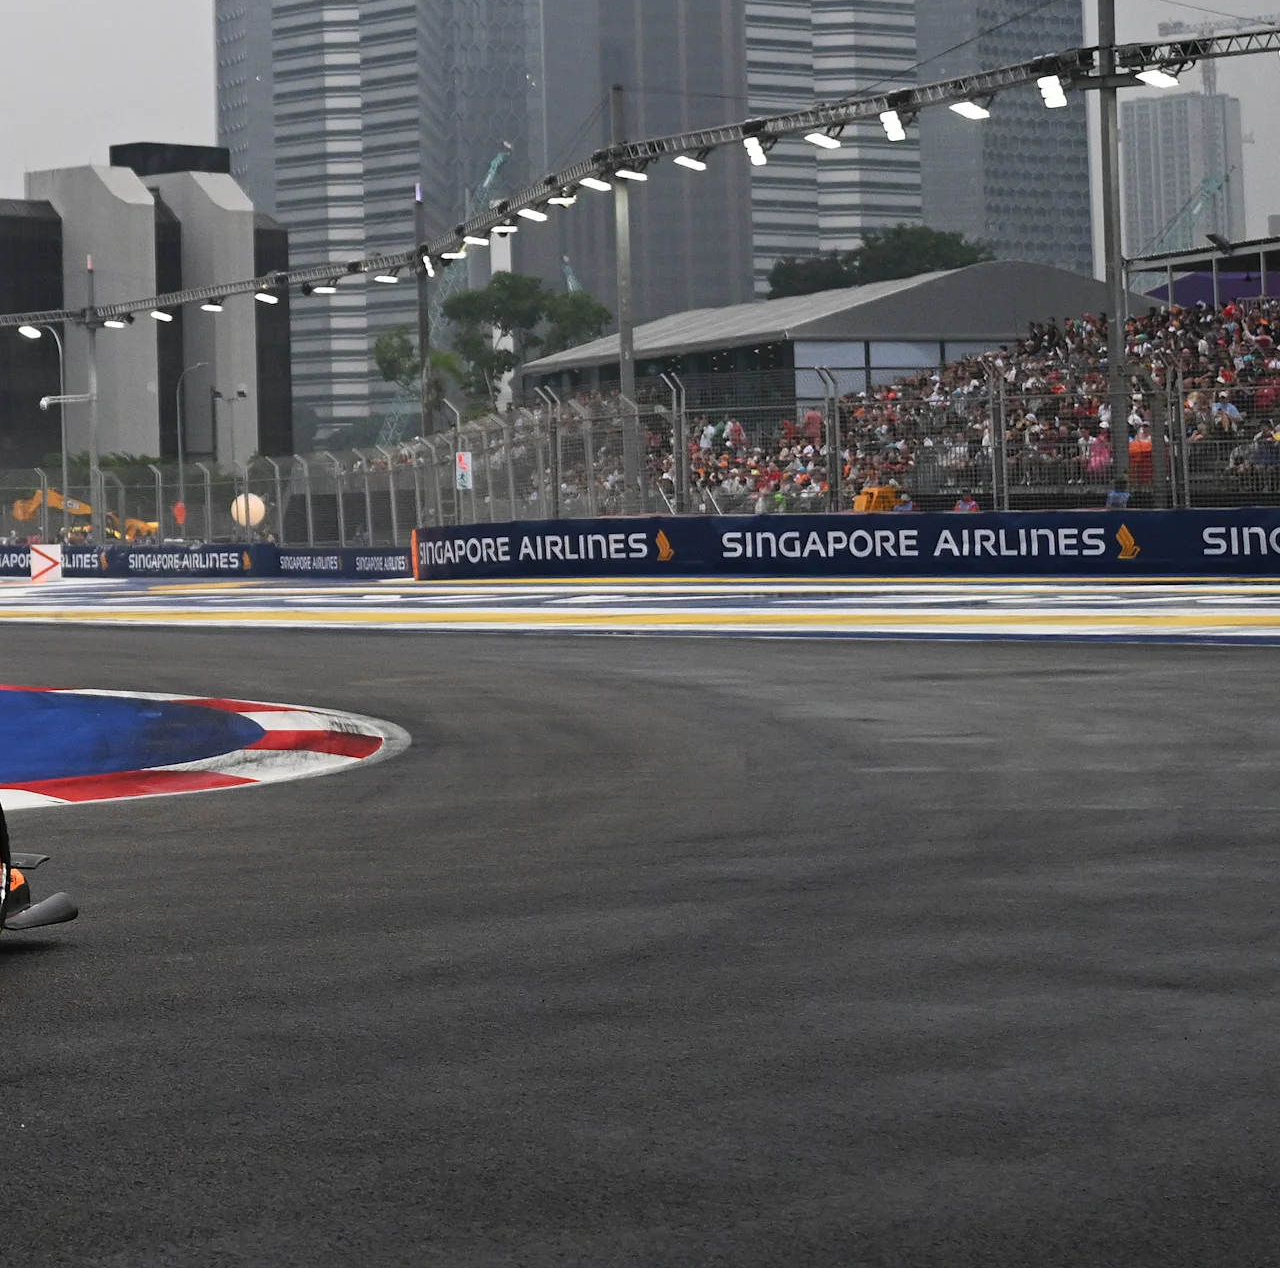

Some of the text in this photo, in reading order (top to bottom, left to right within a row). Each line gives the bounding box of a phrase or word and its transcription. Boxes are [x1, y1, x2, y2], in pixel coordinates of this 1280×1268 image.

[419, 533, 648, 565] SINGAPORE AIRLINES
[722, 528, 1106, 557] SINGAPORE AIRLINES
[60, 553, 98, 569] RLINES
[128, 552, 239, 569] SINGAPORE AIRLINES
[280, 556, 338, 570] SINGAPORE AIRLINES
[384, 556, 406, 571] AIRLINES
